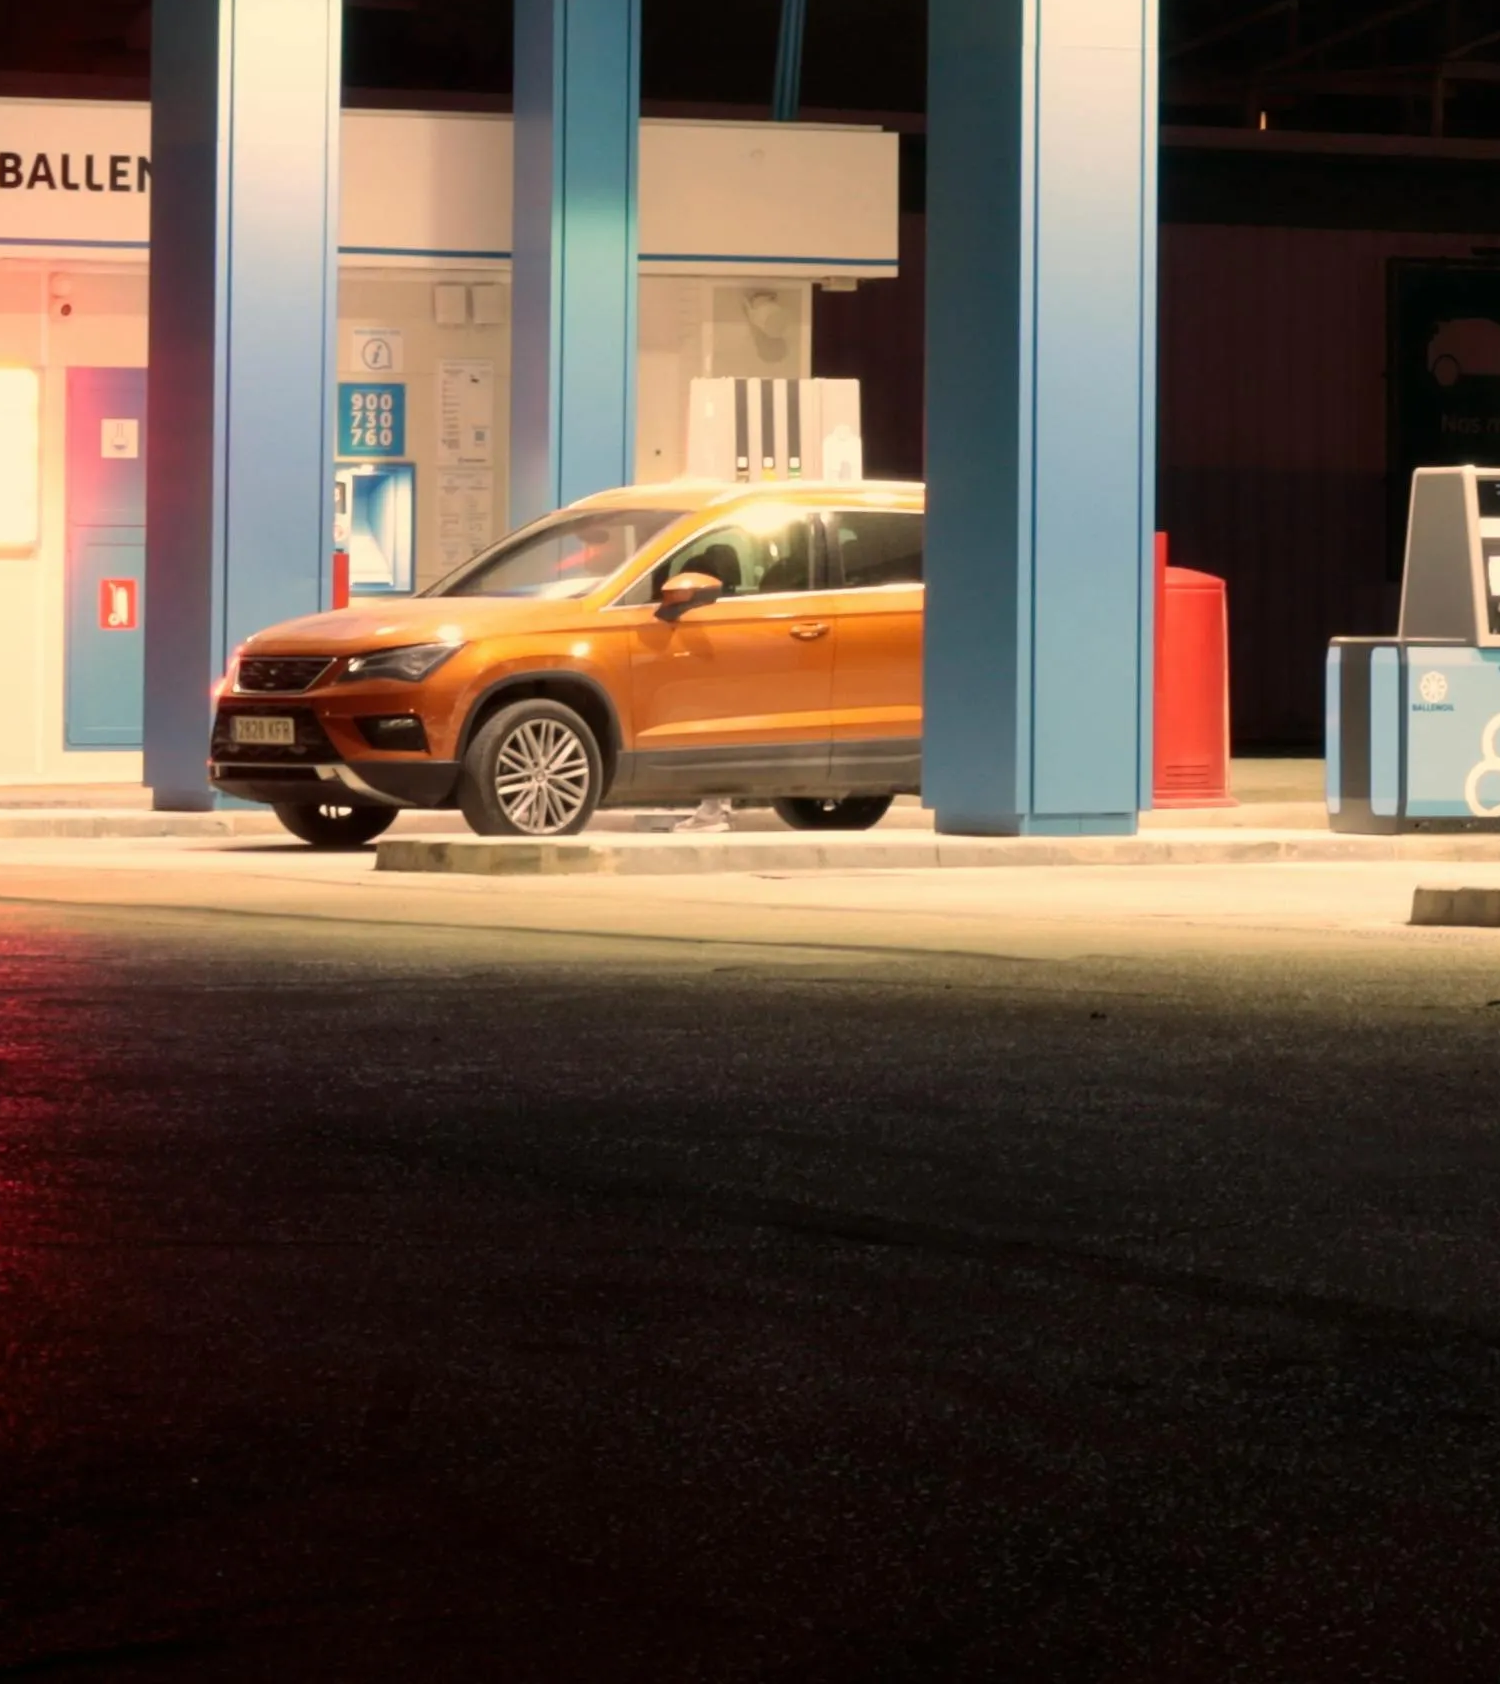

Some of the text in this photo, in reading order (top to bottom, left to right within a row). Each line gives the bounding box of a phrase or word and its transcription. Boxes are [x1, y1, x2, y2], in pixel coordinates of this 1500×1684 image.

[350, 393, 393, 410] 900
[350, 411, 393, 428] 730
[350, 428, 393, 446] 760
